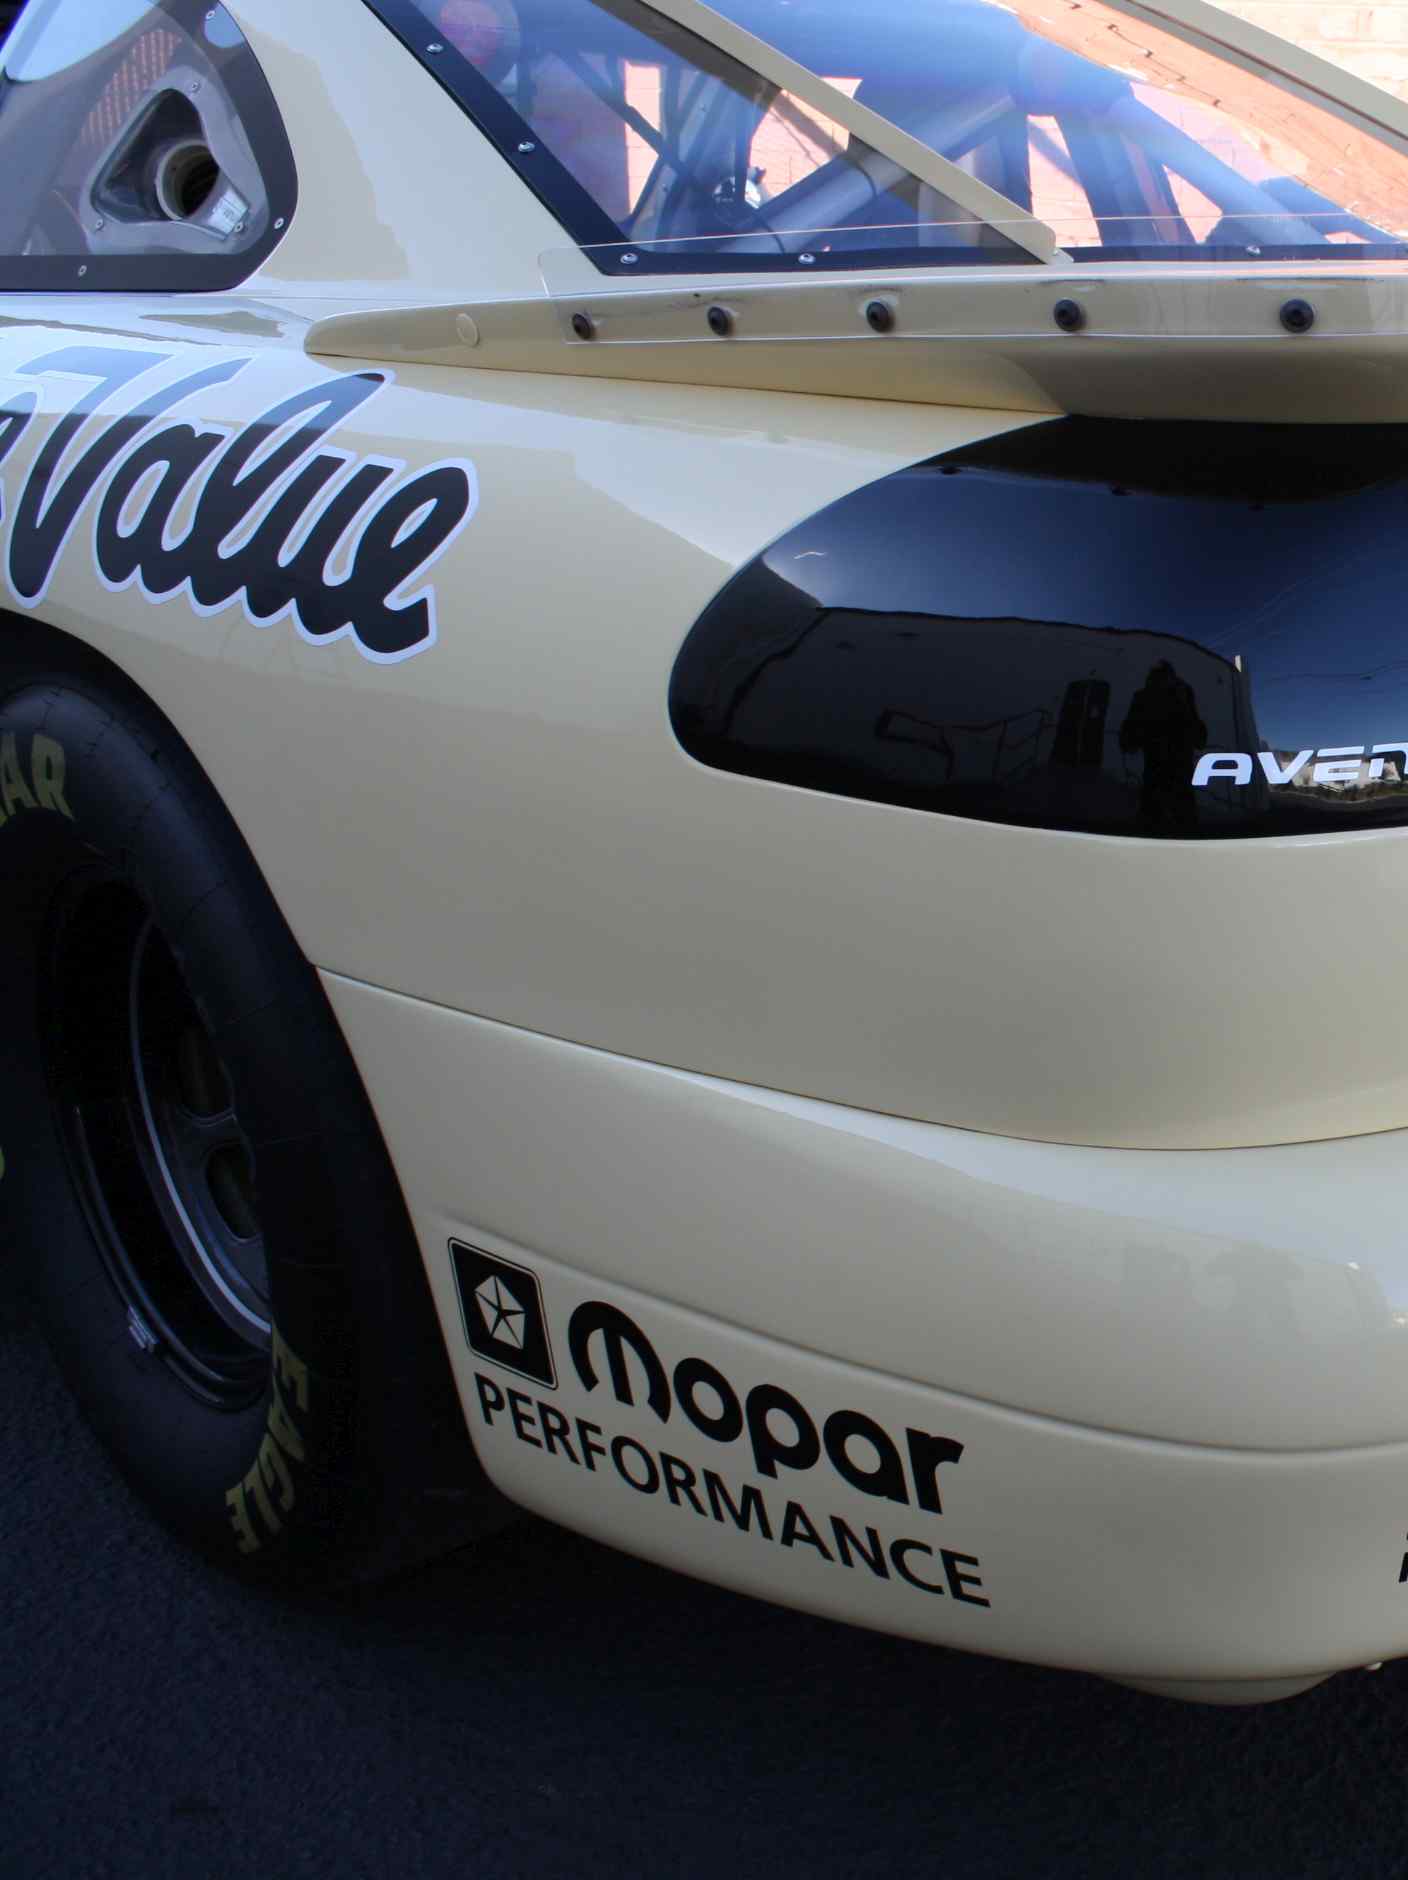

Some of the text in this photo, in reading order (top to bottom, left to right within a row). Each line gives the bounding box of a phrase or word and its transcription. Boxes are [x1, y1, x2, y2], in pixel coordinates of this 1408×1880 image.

[8, 344, 478, 663] Value
[0, 731, 74, 824] AR
[473, 1371, 992, 1608] PERFORMANCE
